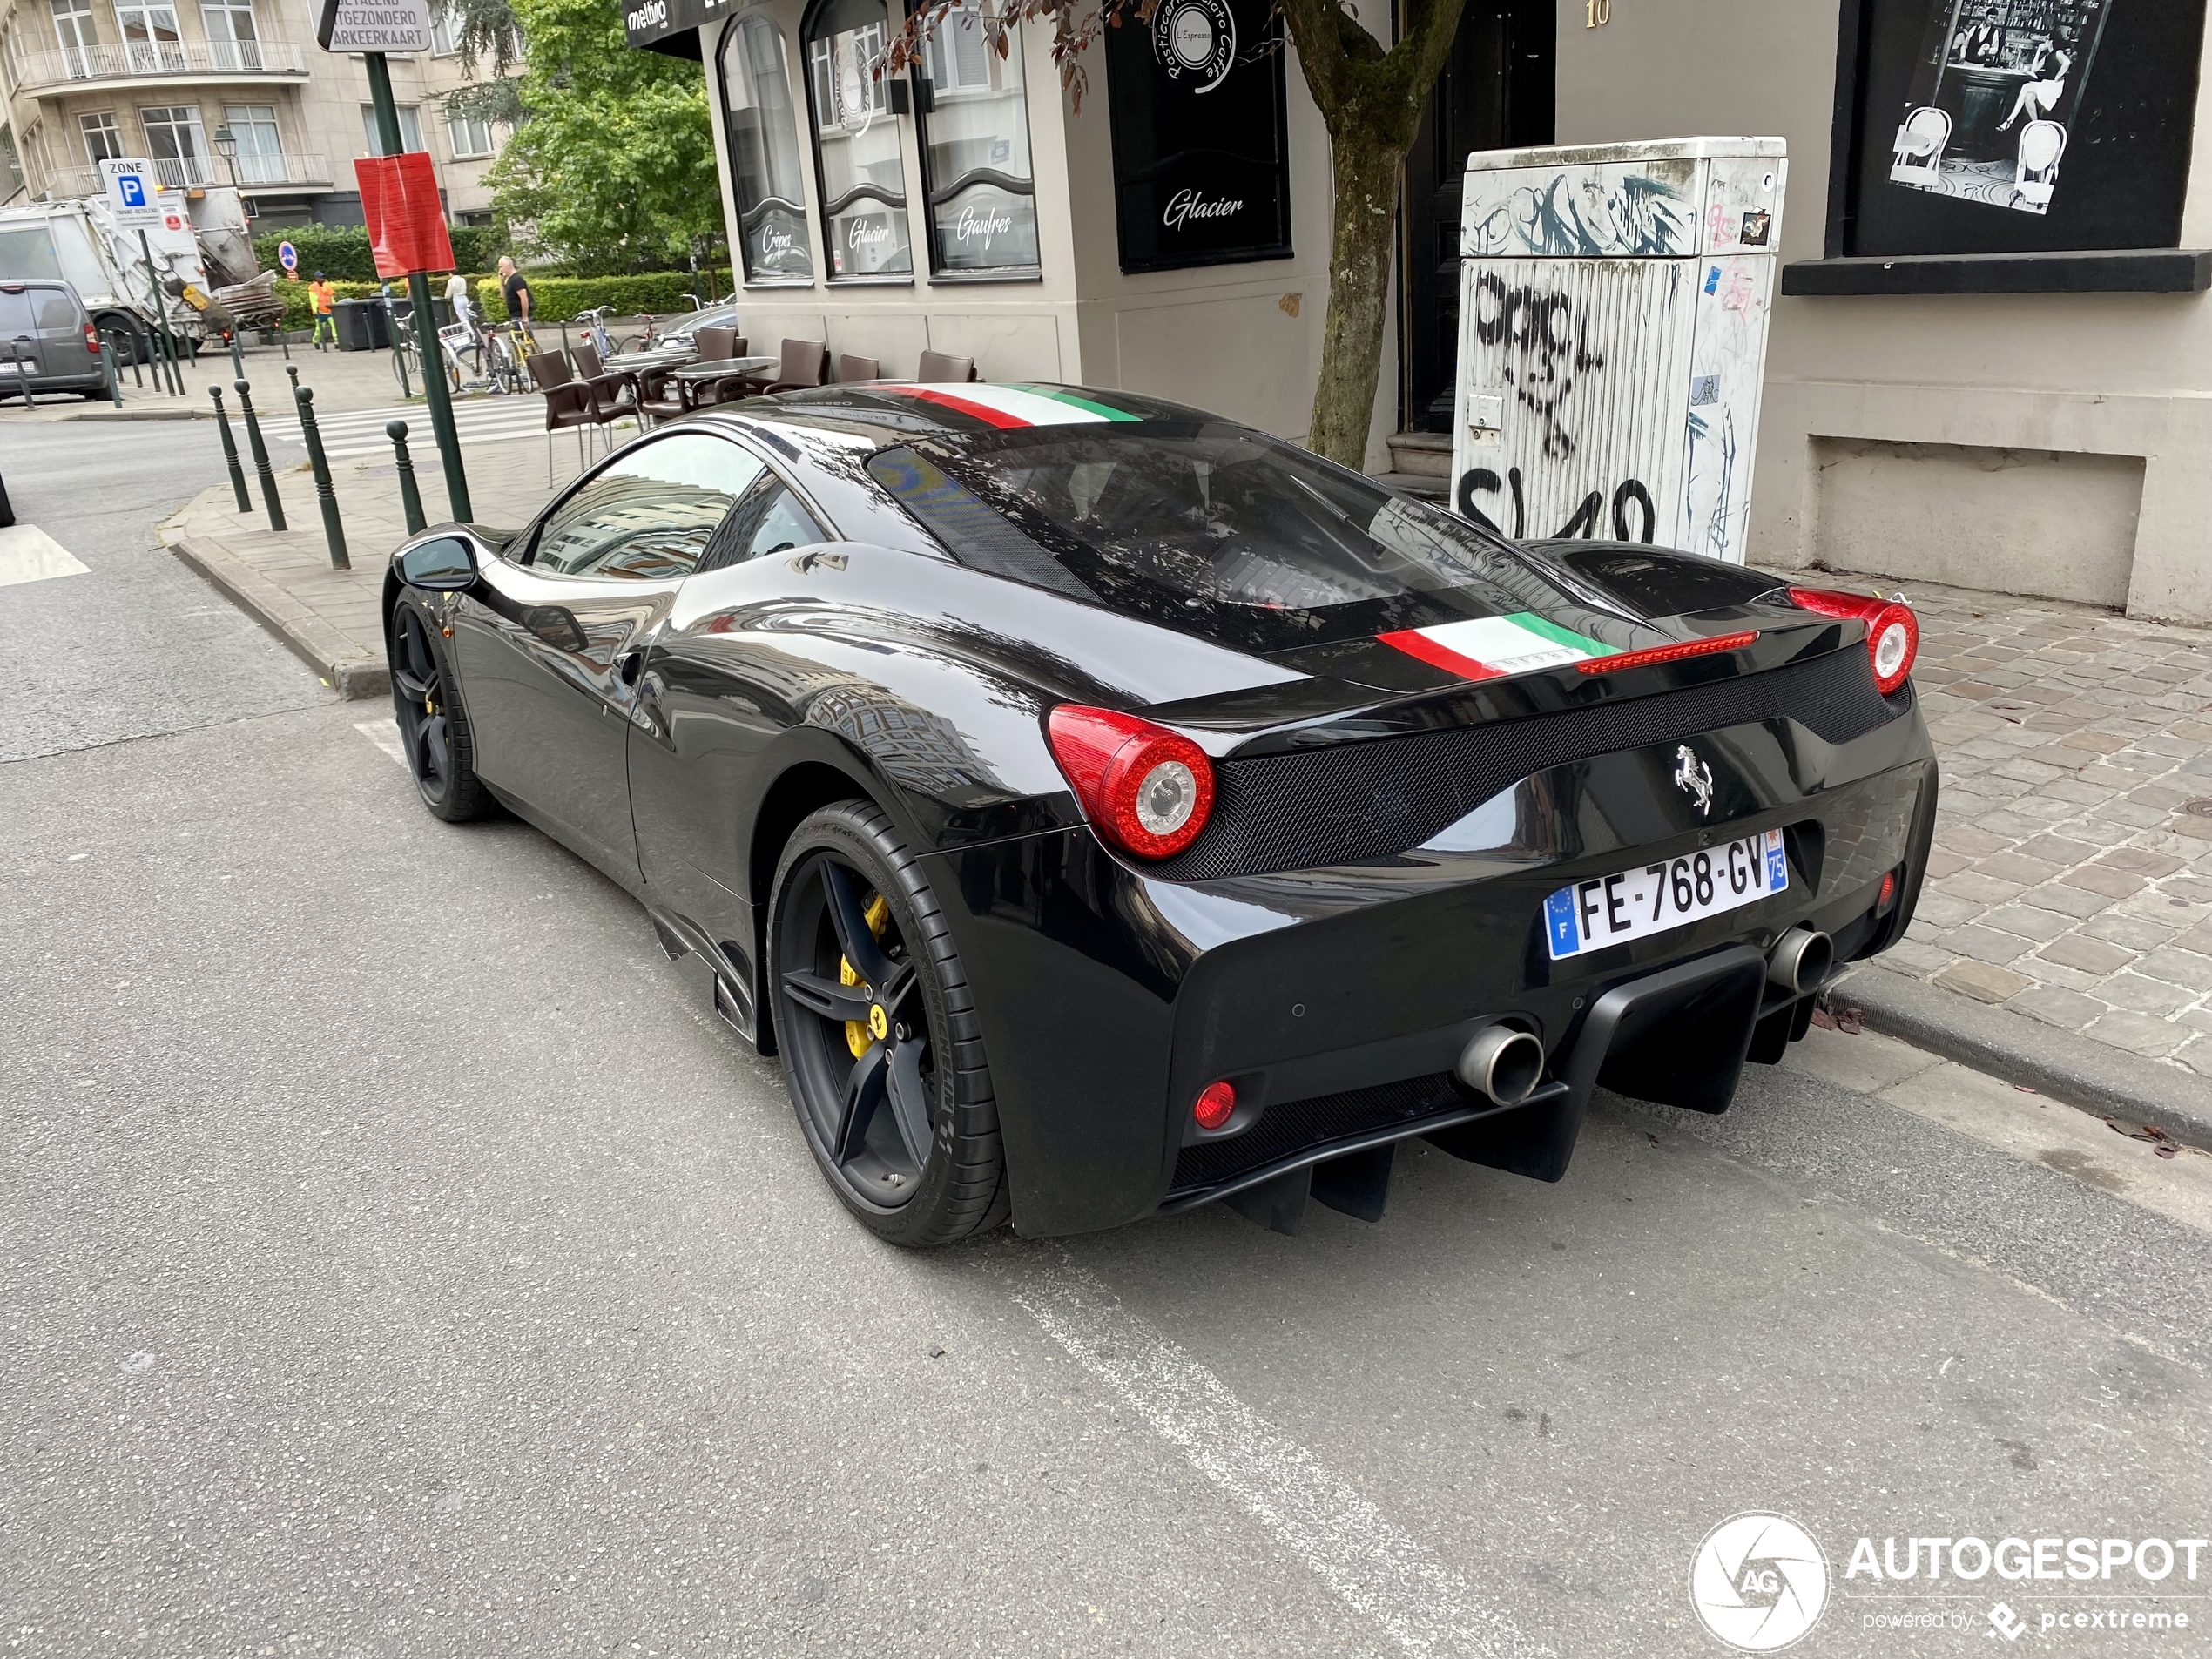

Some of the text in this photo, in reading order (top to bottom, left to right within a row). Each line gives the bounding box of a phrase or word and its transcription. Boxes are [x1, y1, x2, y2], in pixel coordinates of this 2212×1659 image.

[628, 0, 666, 30] meltino
[1586, 0, 1610, 28] 10
[334, 30, 422, 45] ARKEERKAART
[1177, 30, 1211, 42] L'Espresso
[1206, 35, 1232, 78] Caffe
[109, 163, 143, 173] ZONE
[121, 180, 139, 202] P
[1163, 188, 1244, 231] Glacier
[762, 225, 792, 259] Crêpes
[848, 218, 890, 253] Glacier
[957, 206, 1012, 250] Gaufres
[1769, 853, 1784, 881] 75
[1578, 833, 1763, 940] FE-768-GV
[1558, 921, 1568, 939] F
